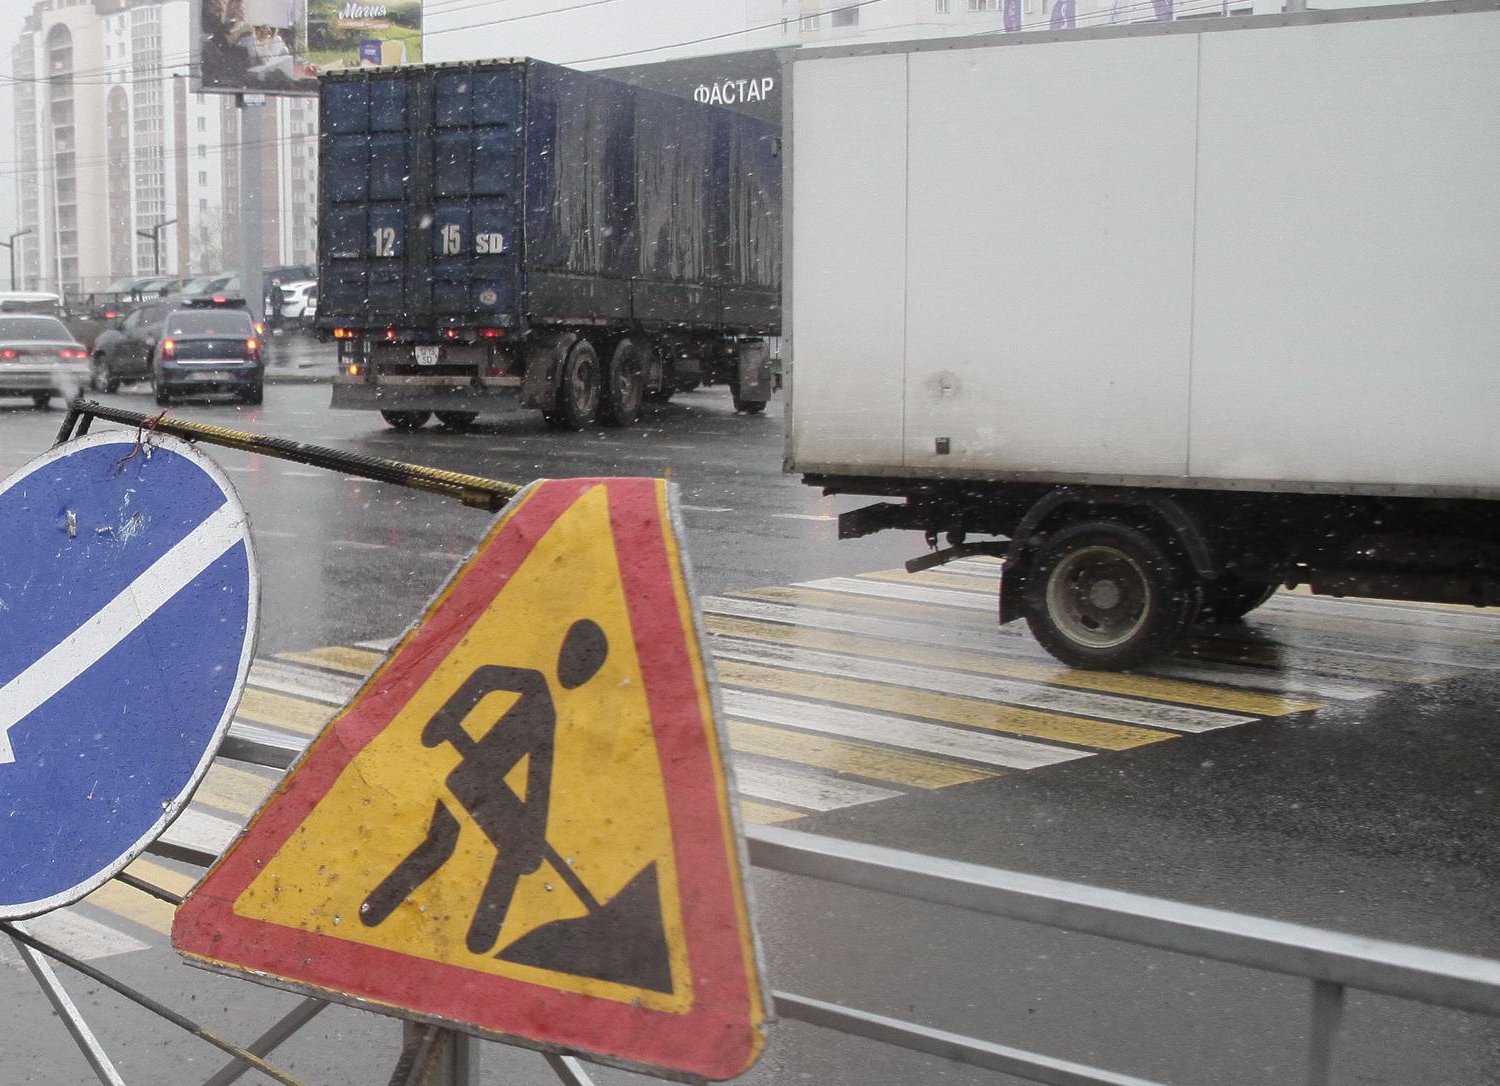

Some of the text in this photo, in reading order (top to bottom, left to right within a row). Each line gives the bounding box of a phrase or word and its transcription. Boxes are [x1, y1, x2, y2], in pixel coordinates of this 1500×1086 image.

[338, 2, 387, 19] Магия
[694, 77, 774, 105] ФАСТАР
[373, 224, 504, 257] 12 15 SD
